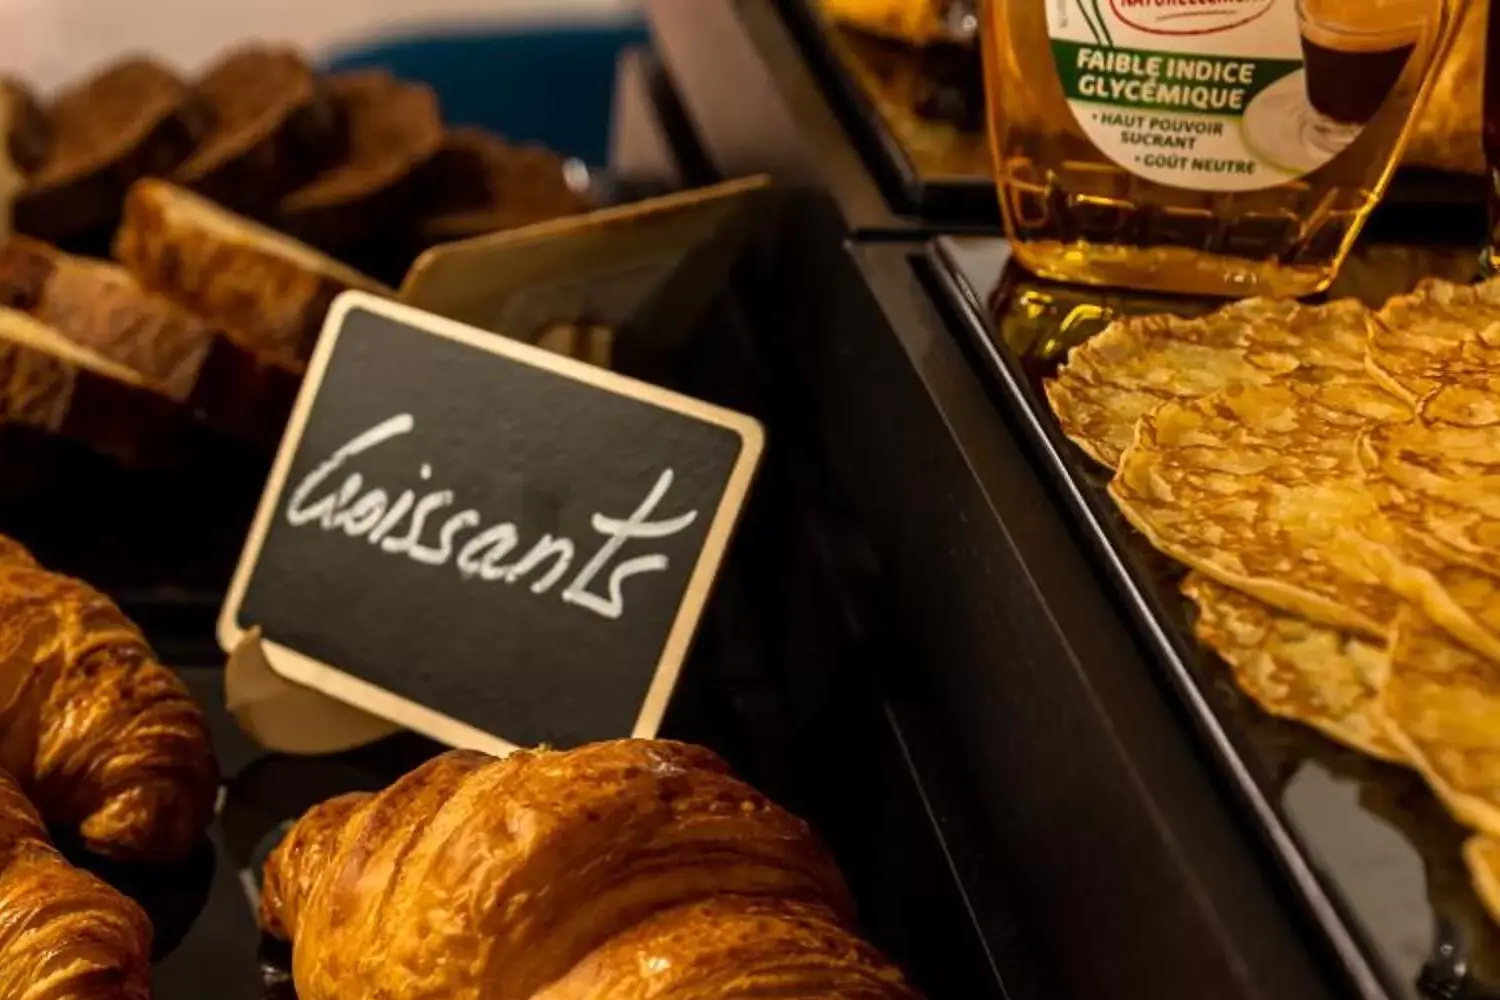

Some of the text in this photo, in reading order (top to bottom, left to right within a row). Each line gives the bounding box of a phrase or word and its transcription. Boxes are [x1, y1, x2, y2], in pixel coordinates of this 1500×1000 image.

[1077, 48, 1256, 84] FAIBLE INDICE
[1078, 74, 1245, 109] GLYCÉMIQUE
[1101, 112, 1224, 136] HAUT POUVOIR
[1121, 131, 1197, 150] SUCRANT
[1143, 152, 1257, 175] GOÛT NEUTRE
[287, 413, 699, 620] Croissants
